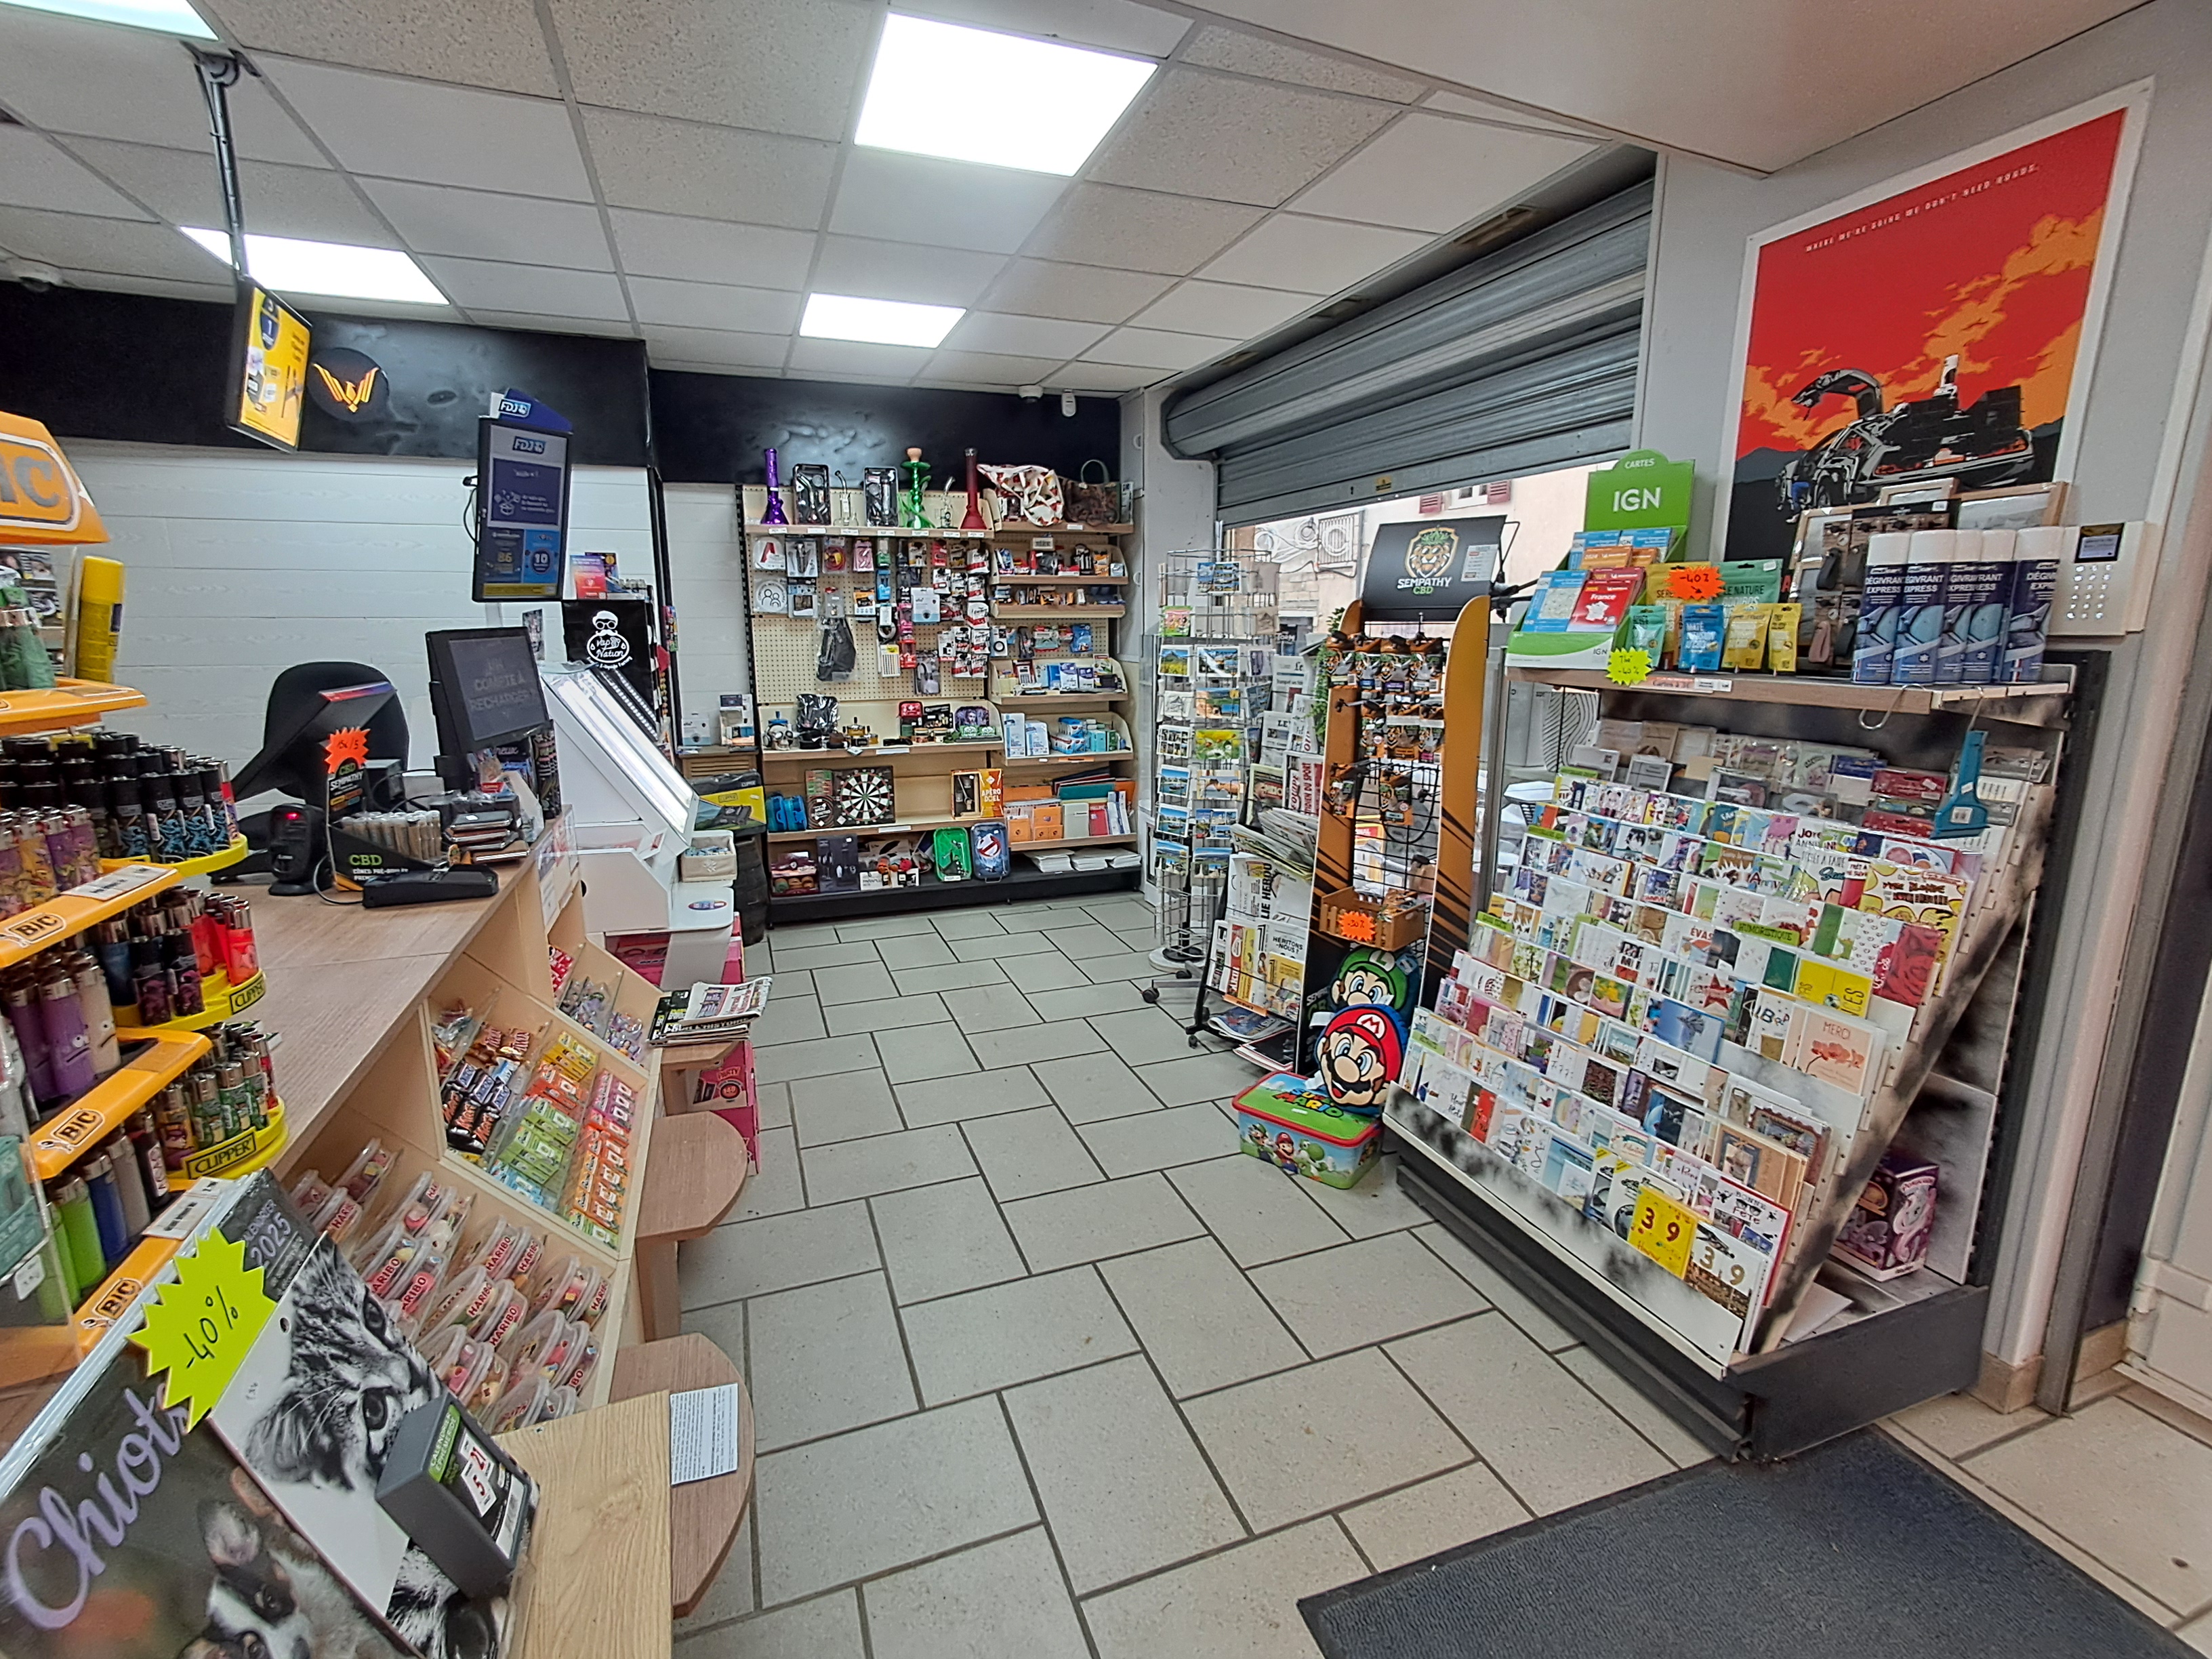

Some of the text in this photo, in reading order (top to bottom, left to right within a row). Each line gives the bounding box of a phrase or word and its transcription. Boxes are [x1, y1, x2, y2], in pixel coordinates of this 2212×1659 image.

[1624, 457, 1656, 470] CARTES
[1612, 487, 1662, 513] IGN
[1397, 577, 1453, 589] SEMPATHY
[1412, 586, 1434, 594] CBD
[1735, 585, 1765, 596] NATURE
[1865, 575, 1904, 585] DÉGIVRAN
[1905, 574, 1944, 584] ÉGIVRANT
[1591, 593, 1616, 601] France
[596, 649, 624, 659] Nation
[348, 855, 383, 866] CBD
[16, 914, 58, 937] BIC
[1690, 926, 1714, 941] ÉVAS
[1273, 936, 1303, 950] HÉRITONS
[1376, 950, 1387, 966] L
[1361, 1016, 1380, 1034] M
[1272, 1092, 1345, 1118] MARIO
[58, 1111, 97, 1144] BIC
[194, 1139, 252, 1173] CLIPPER
[1641, 1207, 1681, 1242] 3 9
[249, 1216, 292, 1268] 2025
[485, 1235, 512, 1273] HARIBO
[370, 1257, 400, 1295] ARIBO
[1700, 1246, 1746, 1286] 3 9
[102, 1282, 136, 1316] BIC
[401, 1274, 427, 1311] ARIBO
[467, 1282, 494, 1317] HARIBO
[184, 1285, 239, 1369] -40%
[488, 1305, 518, 1346] HARIBO
[430, 1412, 451, 1467] CALENDRIER
[470, 1446, 487, 1471] 21
[472, 1475, 485, 1496] 5
[7, 1385, 188, 1629] Chiot
